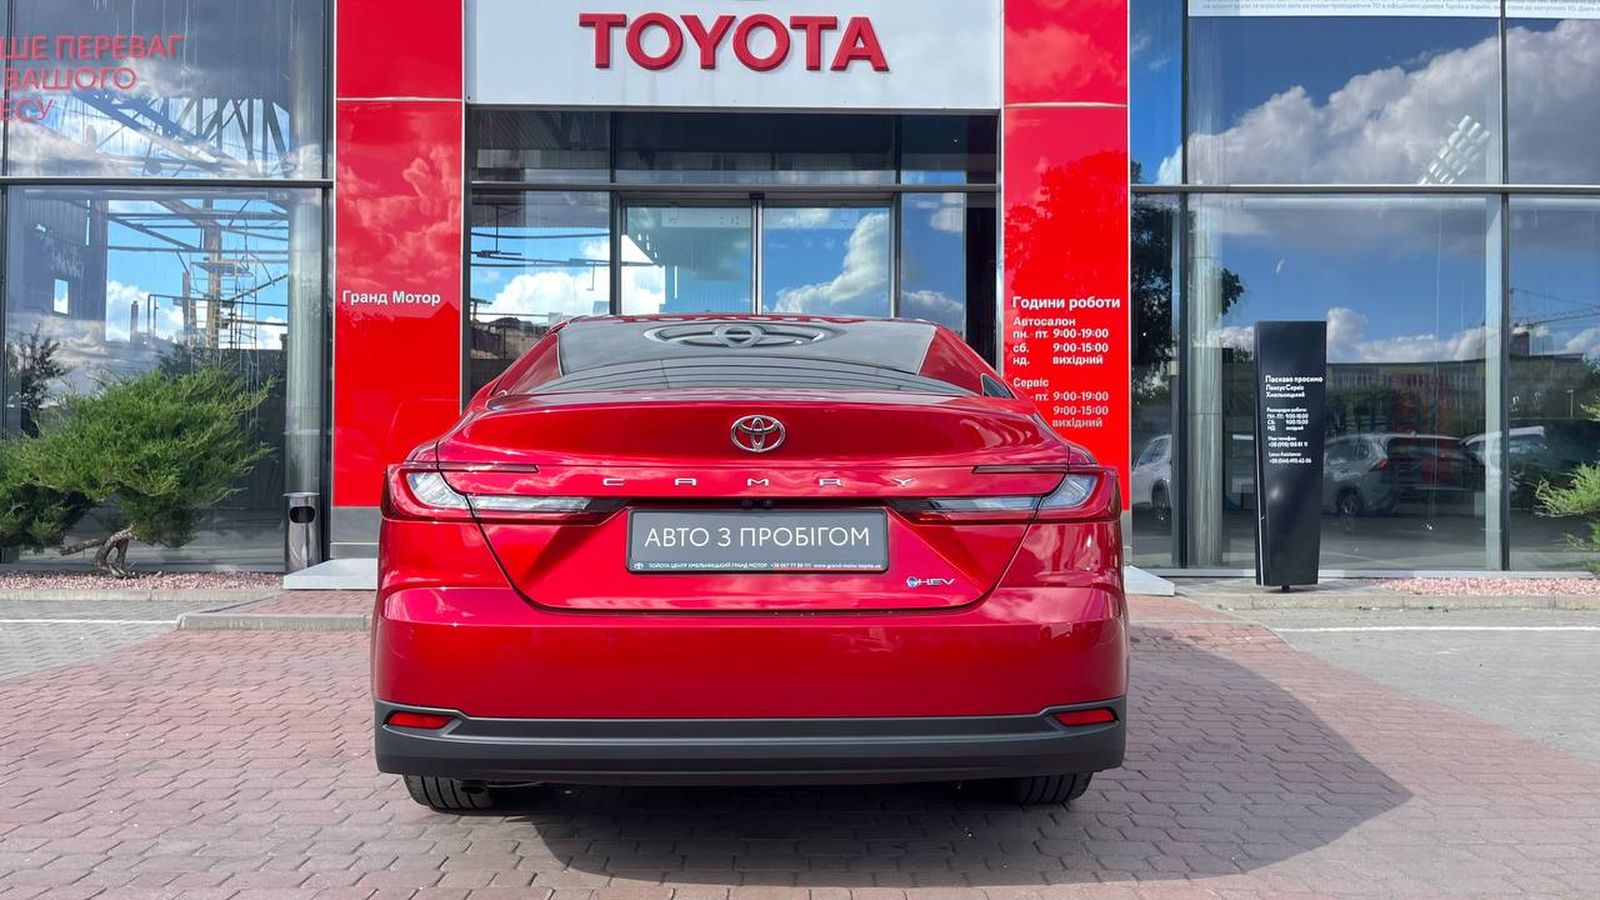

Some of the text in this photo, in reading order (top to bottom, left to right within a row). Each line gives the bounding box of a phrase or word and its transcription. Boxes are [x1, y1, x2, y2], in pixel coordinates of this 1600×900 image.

[56, 35, 185, 60] ПЕРЕВАГ
[579, 12, 889, 72] TOYOTA
[4, 67, 137, 91] ВАШОГО
[342, 290, 441, 306] Гранд Мотор
[1012, 296, 1121, 311] Години роботи
[1013, 316, 1076, 327] Автосалон
[1053, 328, 1109, 339] 9:00-19:00
[1012, 343, 1109, 353] сб. 9:00-15:00
[1013, 355, 1104, 367] нд. вихідний
[1013, 377, 1049, 389] Сервіс
[1294, 376, 1323, 384] просимо
[1053, 391, 1109, 401] 9:00-19:00
[1053, 405, 1109, 415] 9:00-15:00
[1052, 418, 1103, 428] вихідний
[602, 477, 918, 487] CAMRY
[644, 527, 710, 548] АВТО
[740, 526, 870, 548] ПРОБІГОМ
